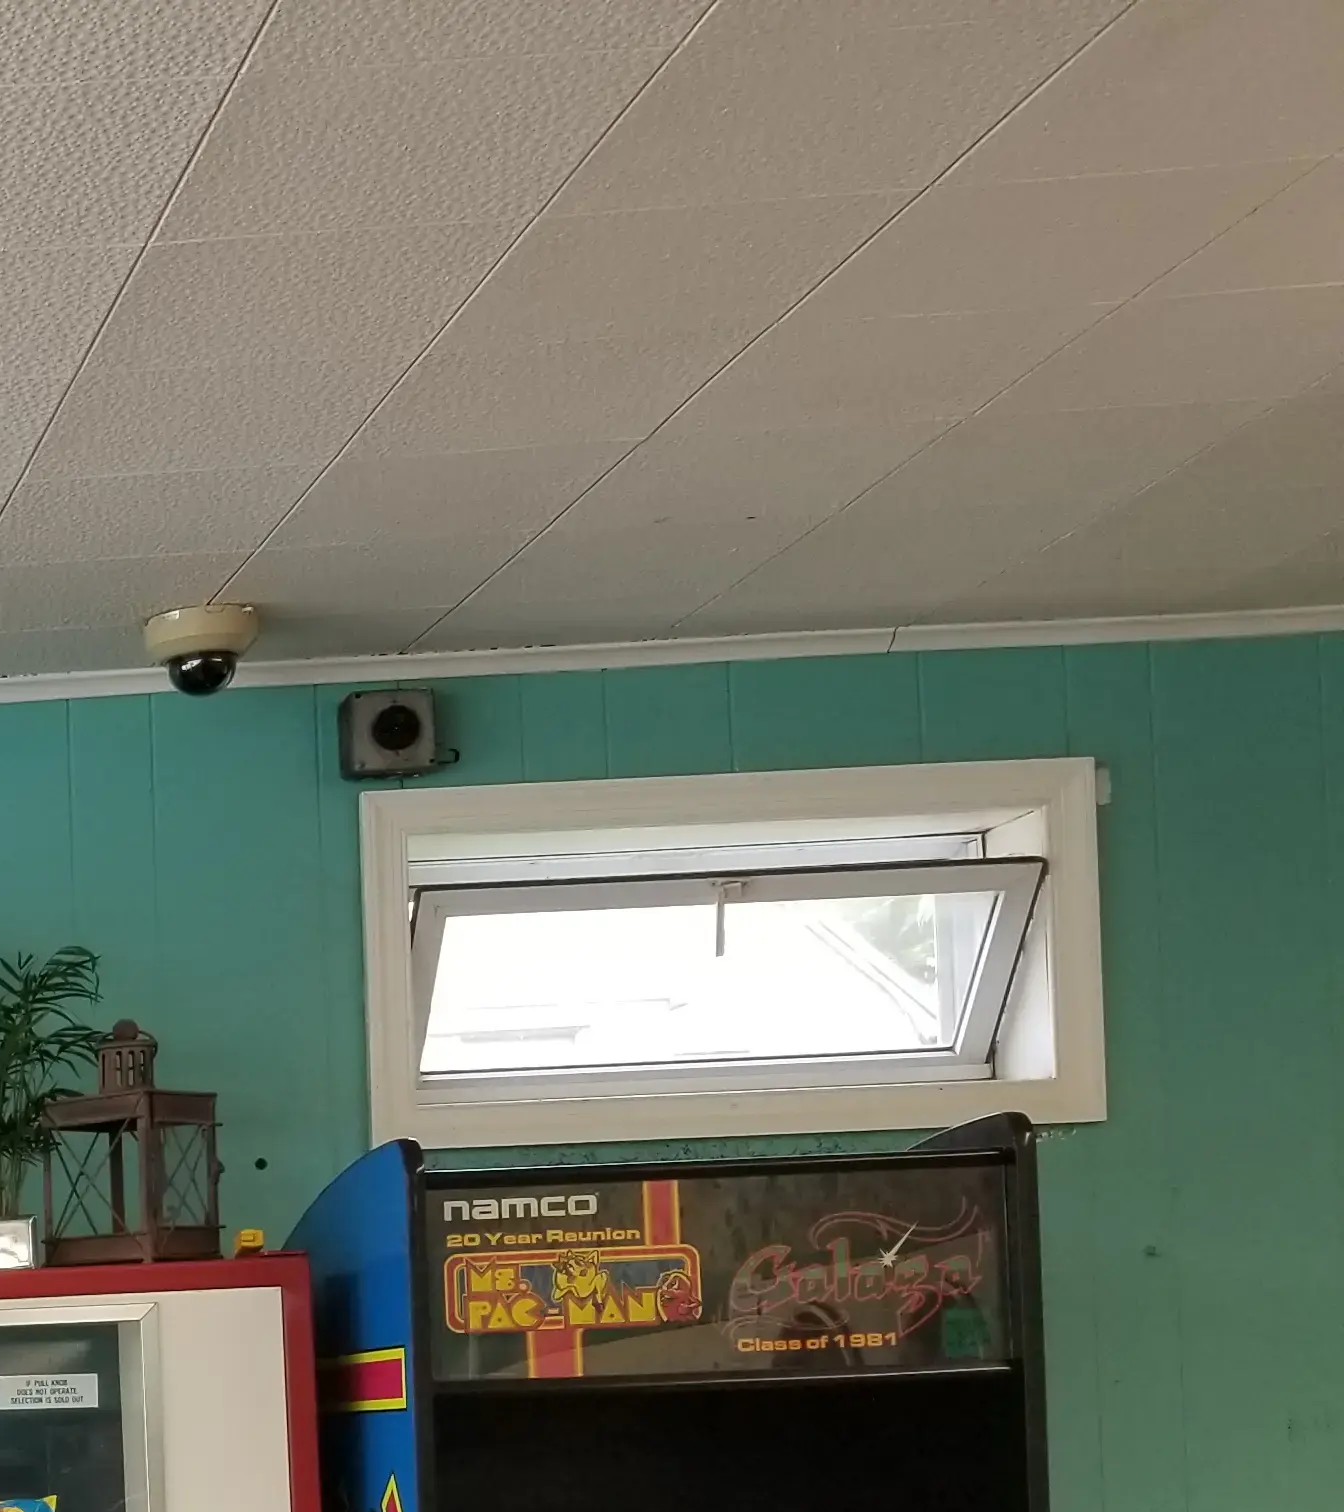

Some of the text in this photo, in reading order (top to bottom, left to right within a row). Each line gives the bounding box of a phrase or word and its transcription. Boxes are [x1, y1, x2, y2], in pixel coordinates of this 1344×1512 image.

[443, 1194, 598, 1222] namco
[446, 1228, 641, 1247] 20 Year Reunion
[729, 1237, 983, 1336] Galaga
[469, 1292, 657, 1329] PAC-MAN
[737, 1332, 898, 1352] Class of 1981
